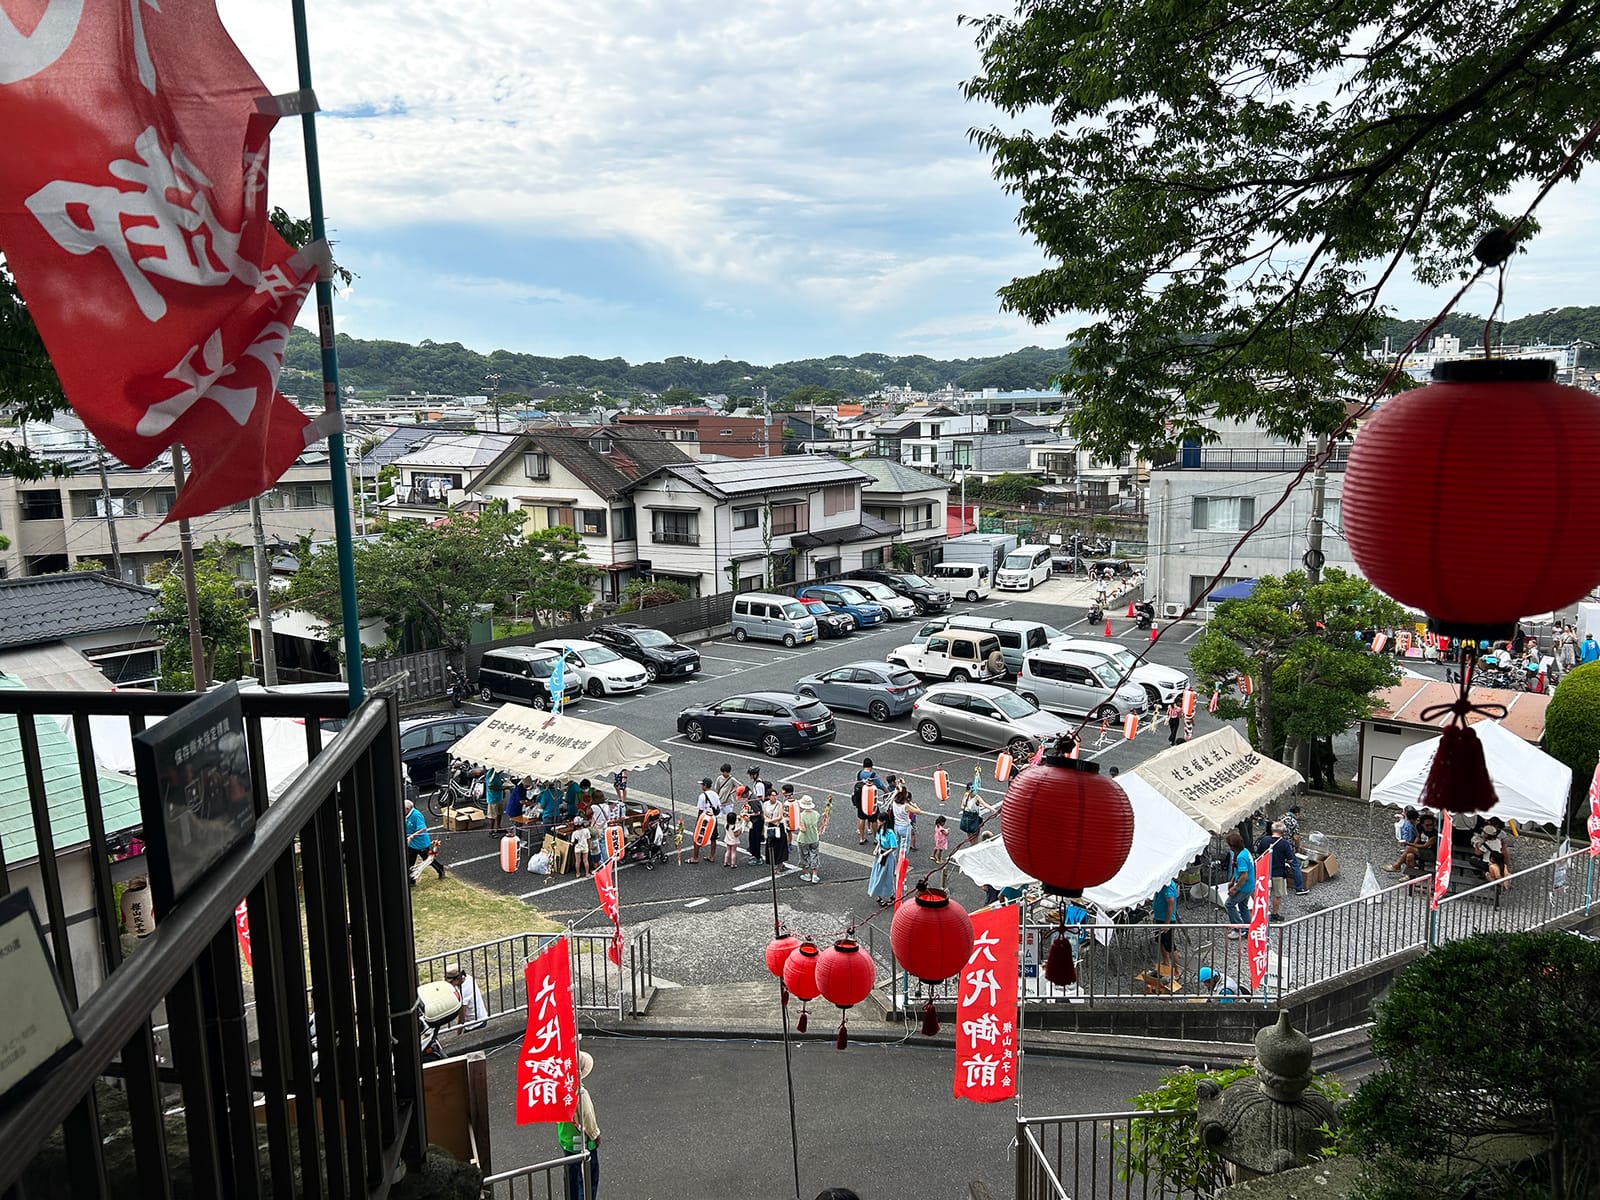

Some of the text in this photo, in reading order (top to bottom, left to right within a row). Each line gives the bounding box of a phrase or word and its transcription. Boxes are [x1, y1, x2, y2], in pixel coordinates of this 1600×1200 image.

[1171, 745, 1232, 782] 社会福祉法人
